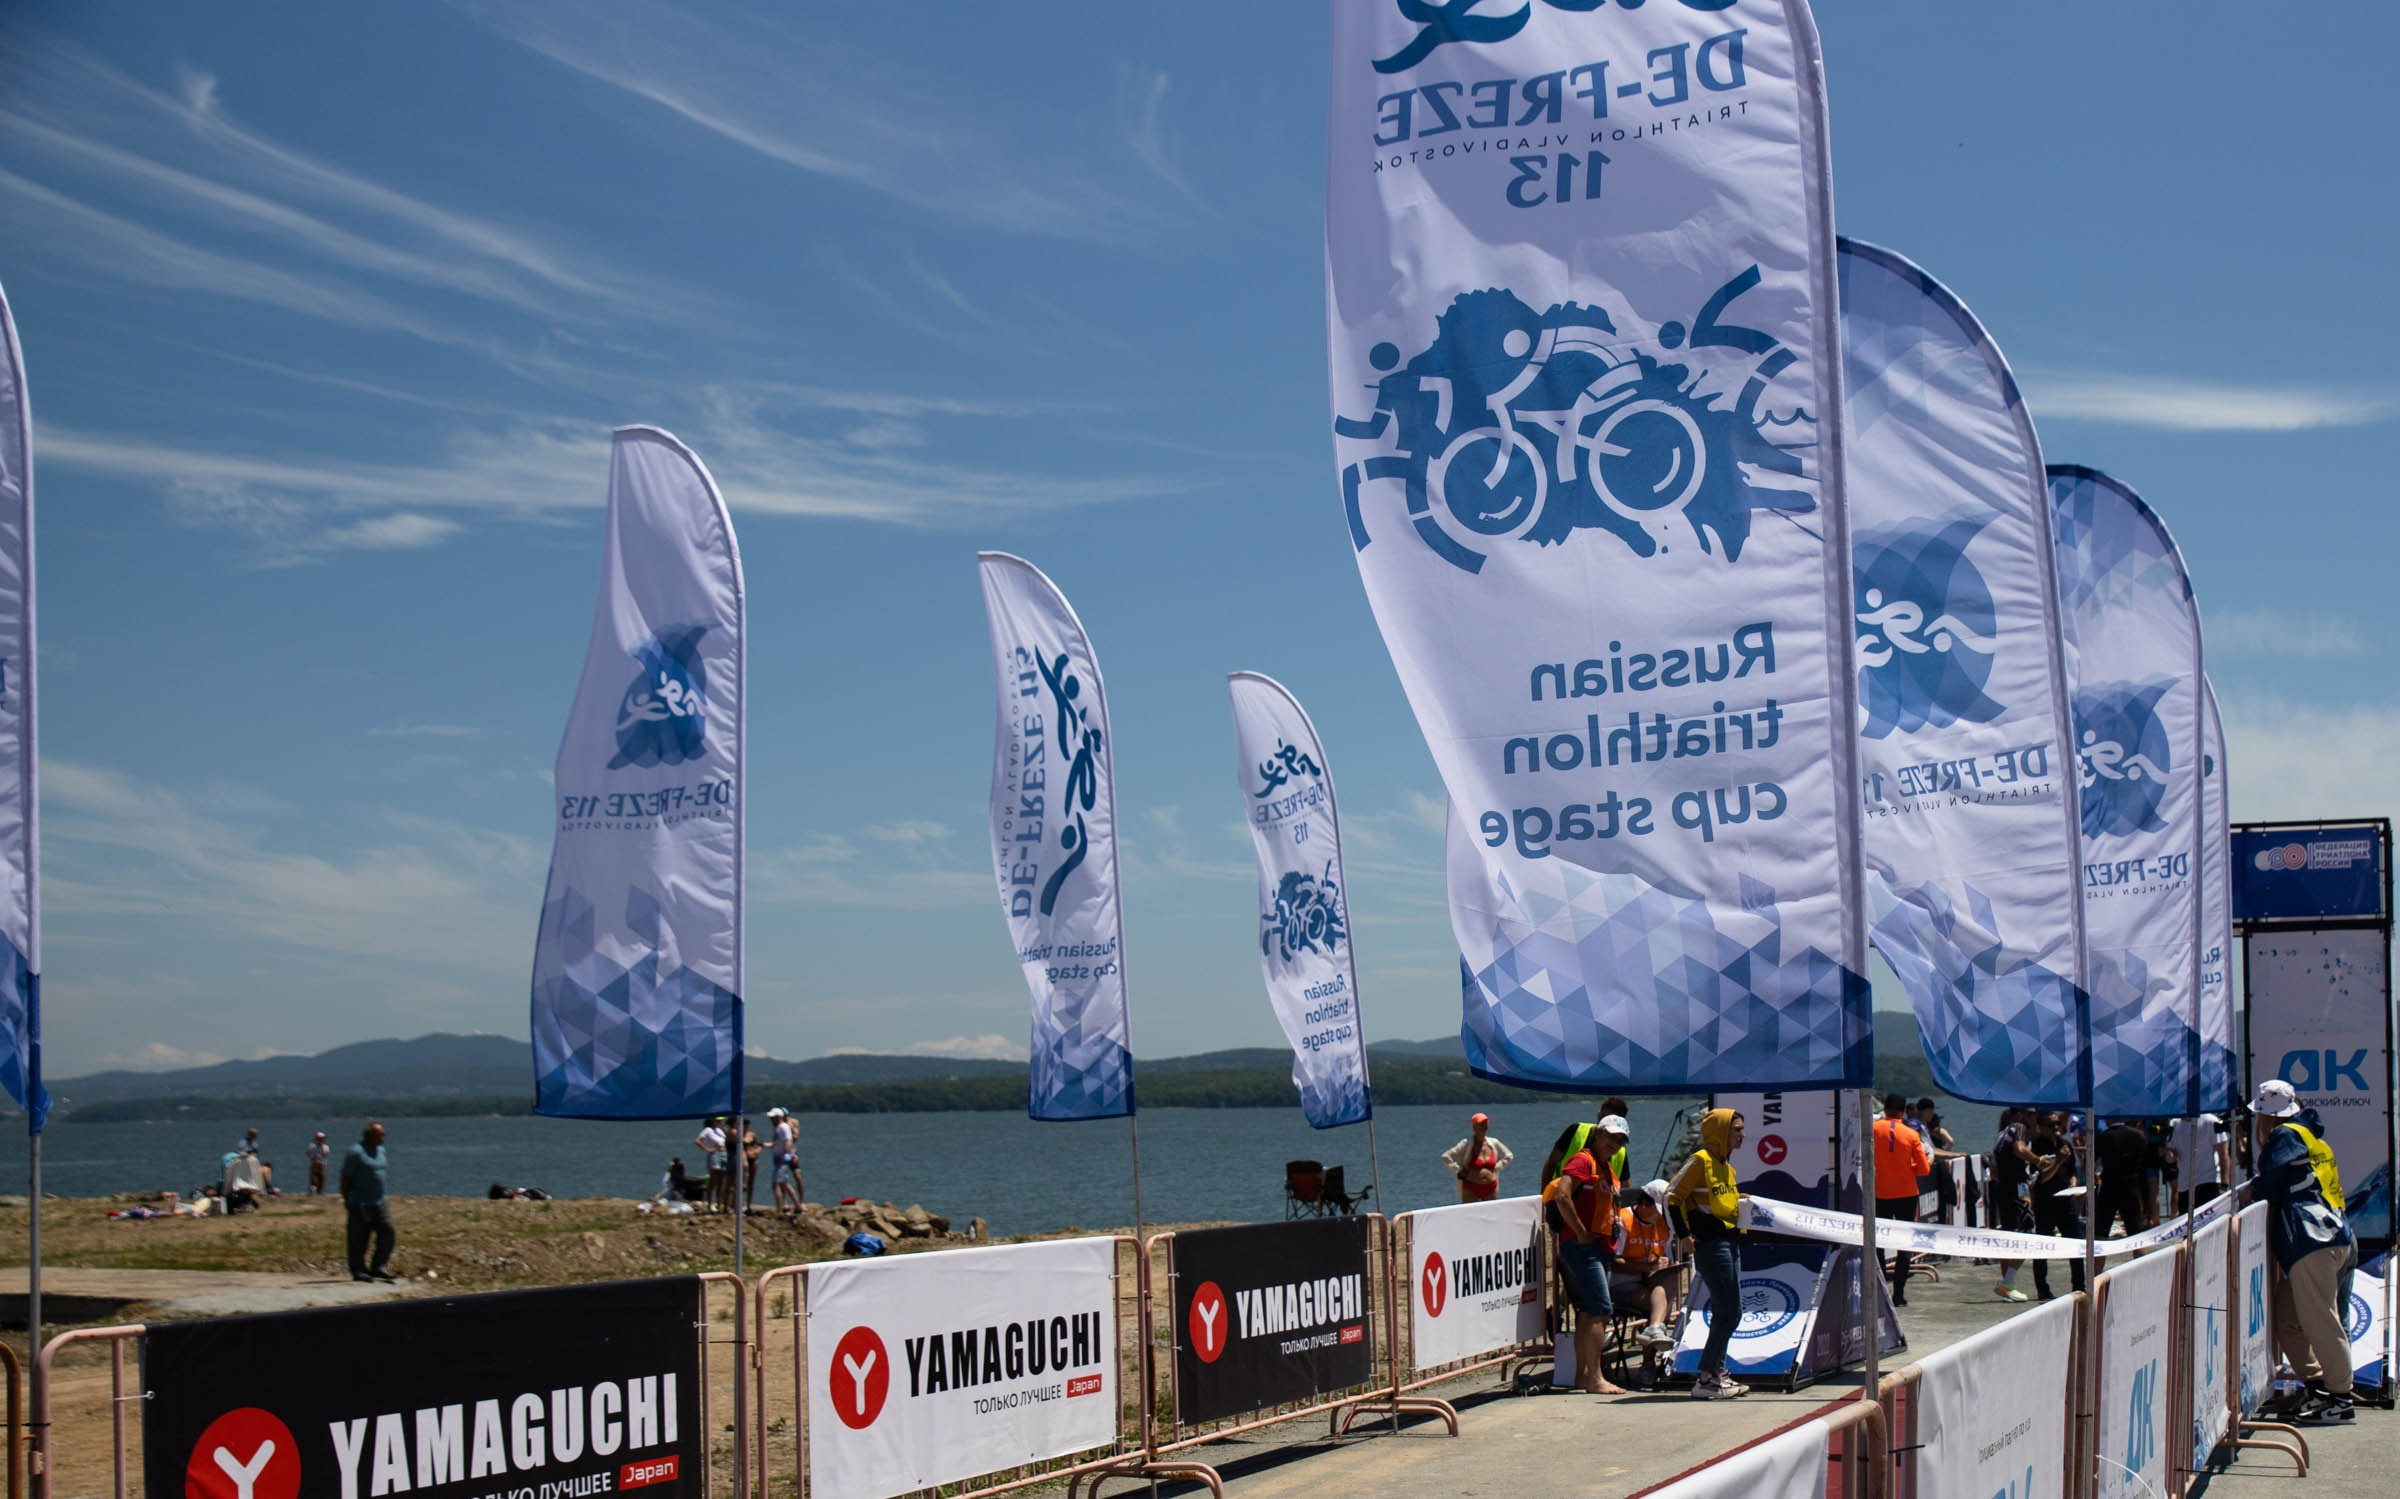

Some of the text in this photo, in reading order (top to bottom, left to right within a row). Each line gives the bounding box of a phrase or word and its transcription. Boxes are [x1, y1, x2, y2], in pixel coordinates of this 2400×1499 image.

[1452, 1246, 1537, 1299] YAMAGUCHI
[1236, 1274, 1363, 1339] YAMAGUCHI
[1280, 1332, 1338, 1355] ТОЛЬКО ЛУЧШЕЕ
[1342, 1328, 1361, 1342] Japan
[905, 1311, 1101, 1397] YAMAGUCHI
[973, 1384, 1062, 1415] ТОЛЬКО ЛУЧШЕЕ
[1069, 1378, 1100, 1395] Japan
[329, 1372, 678, 1499] YAMAGUCHI
[538, 1471, 612, 1499] ЛУЧШЕЕ
[625, 1461, 674, 1484] Japan
